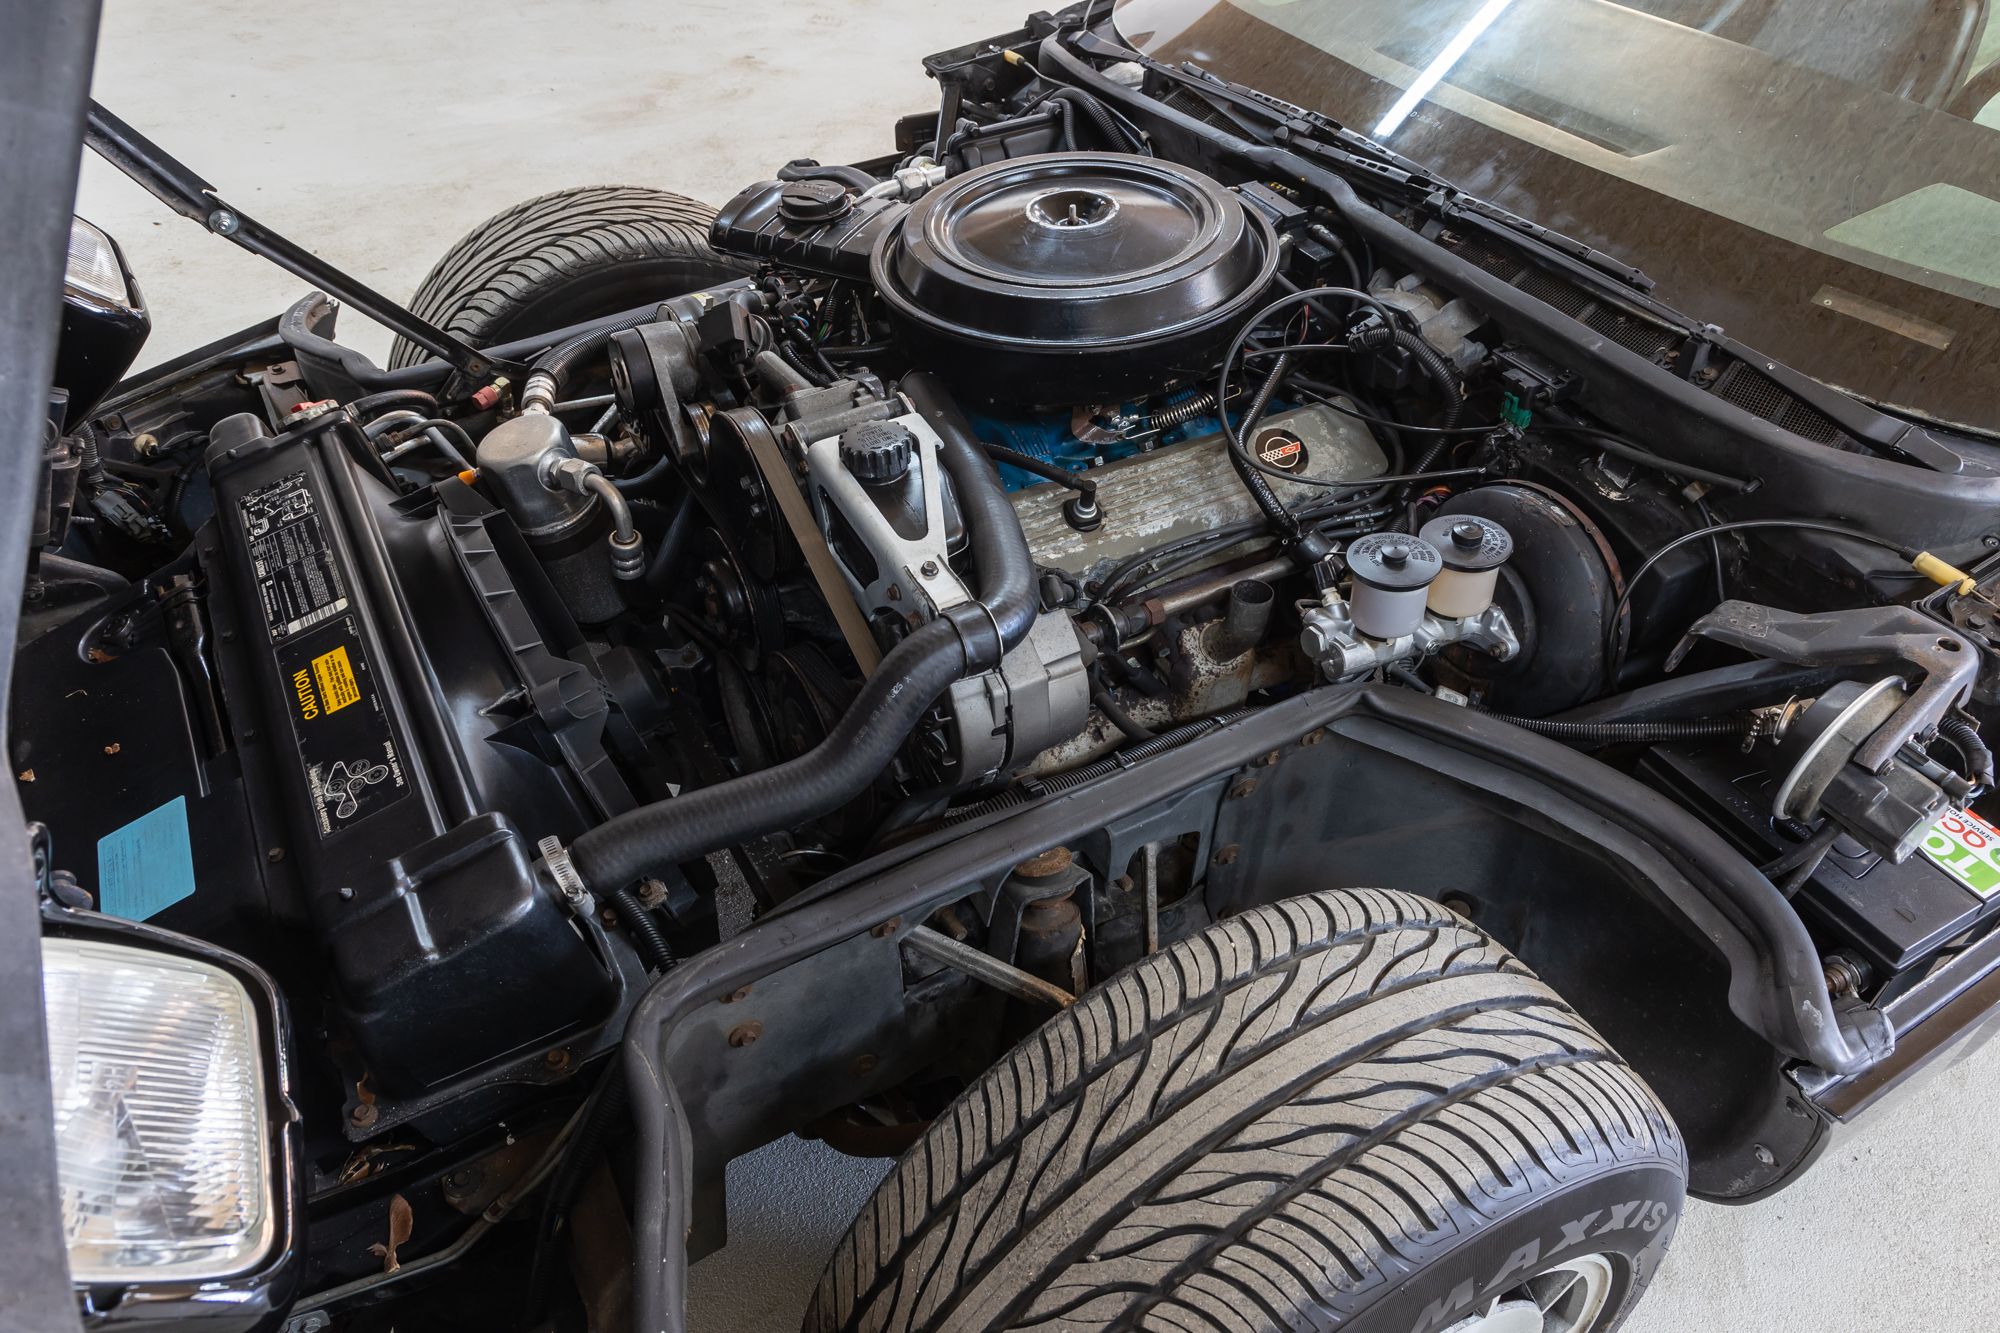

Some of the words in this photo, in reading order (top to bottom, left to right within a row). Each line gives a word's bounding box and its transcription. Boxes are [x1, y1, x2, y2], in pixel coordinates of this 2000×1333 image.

[292, 668, 318, 720] CAUTION
[383, 740, 396, 760] Manual
[389, 757, 401, 778] Owner's
[395, 776, 404, 788] See
[320, 807, 332, 834] Accessory
[1963, 819, 1994, 842] SERVICE
[1409, 1200, 1668, 1333] MAXXIS
